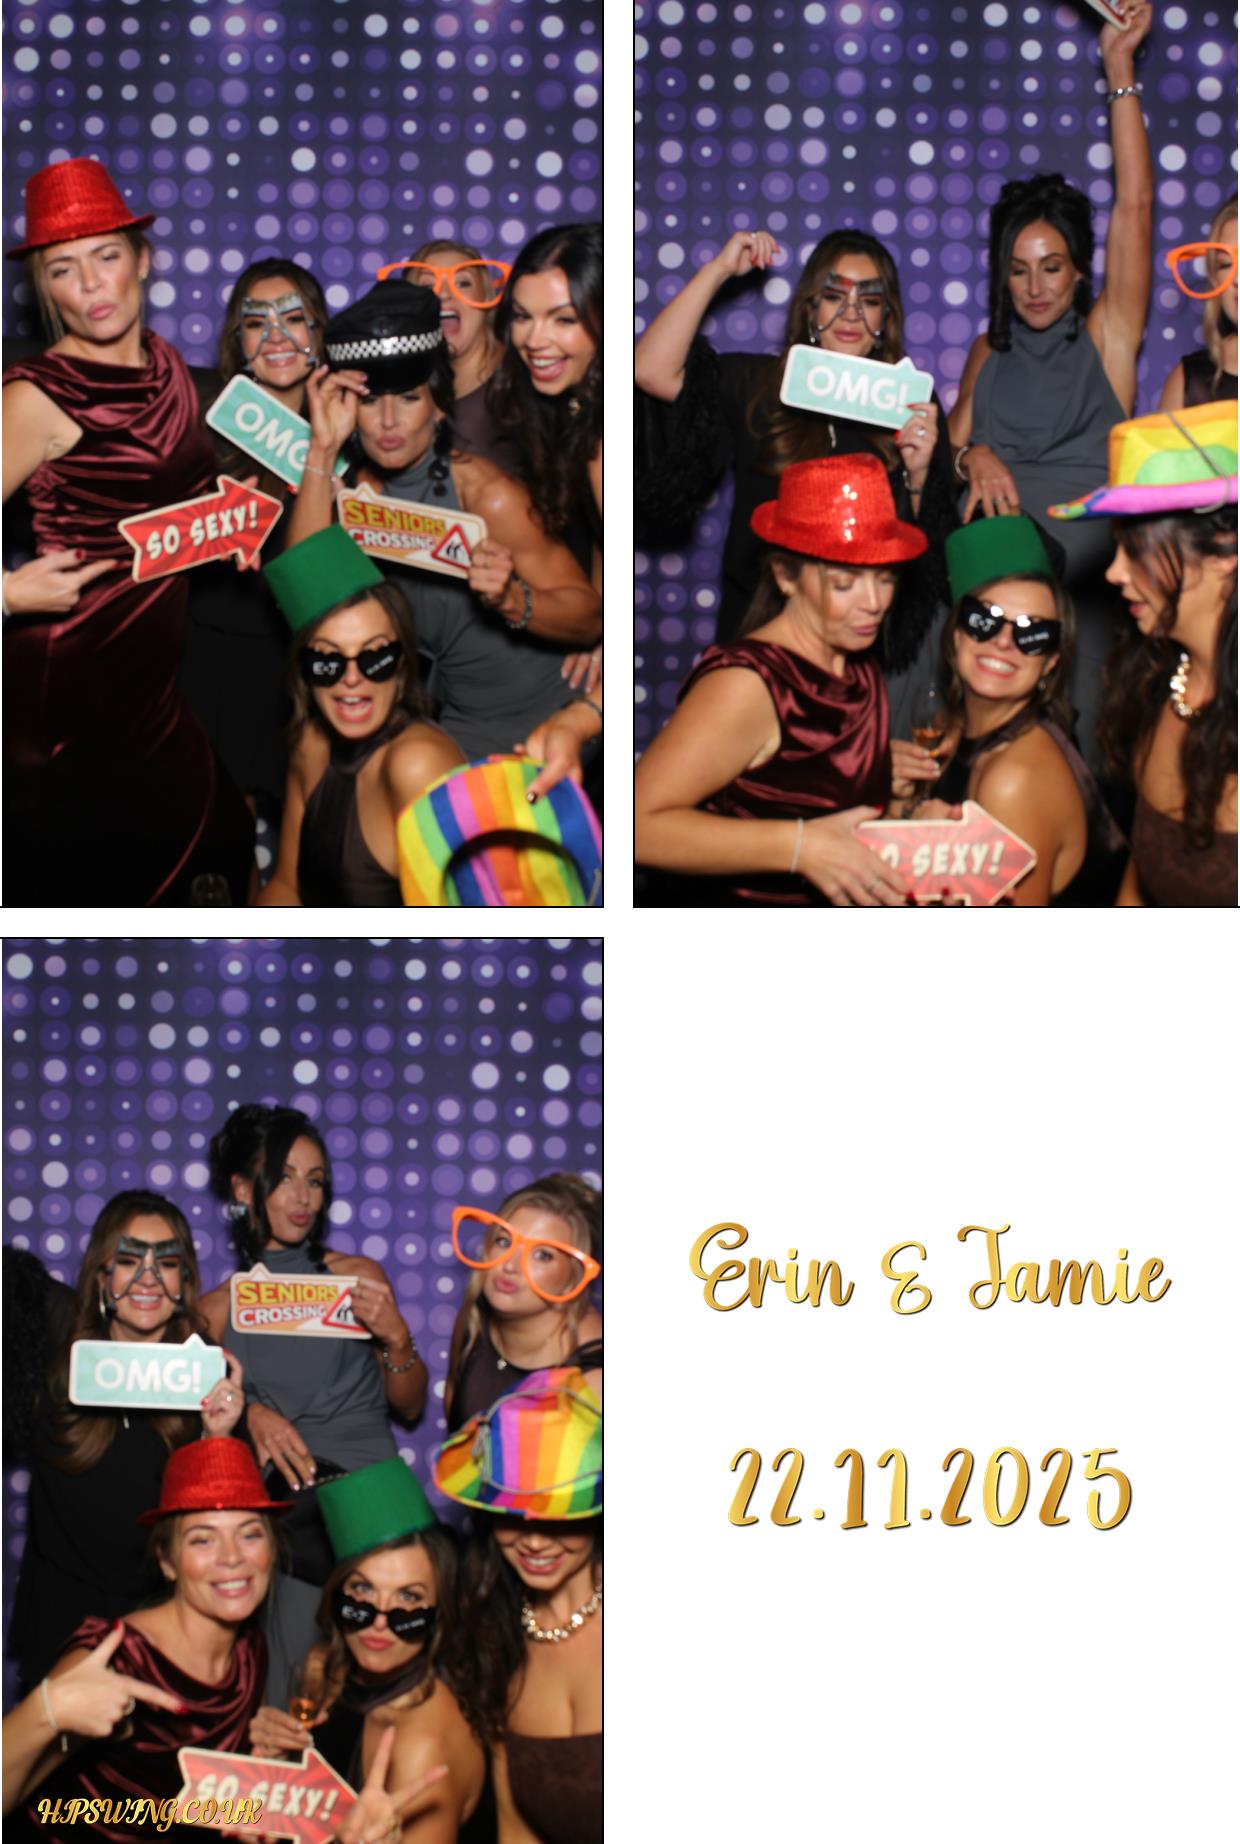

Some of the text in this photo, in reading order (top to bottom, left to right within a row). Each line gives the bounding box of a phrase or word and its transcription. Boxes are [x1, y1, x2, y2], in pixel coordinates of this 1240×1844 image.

[806, 365, 909, 414] OMG!
[235, 402, 311, 470] OMG
[146, 500, 257, 560] SO SEXY!
[344, 499, 447, 537] SENIORS
[350, 528, 437, 552] CROSSING
[912, 840, 1004, 877] SEXY!
[237, 1281, 339, 1305] SENIORS
[239, 1304, 327, 1327] CROSSING
[94, 1357, 201, 1394] OMG!
[196, 1774, 338, 1821] SO SEXY!
